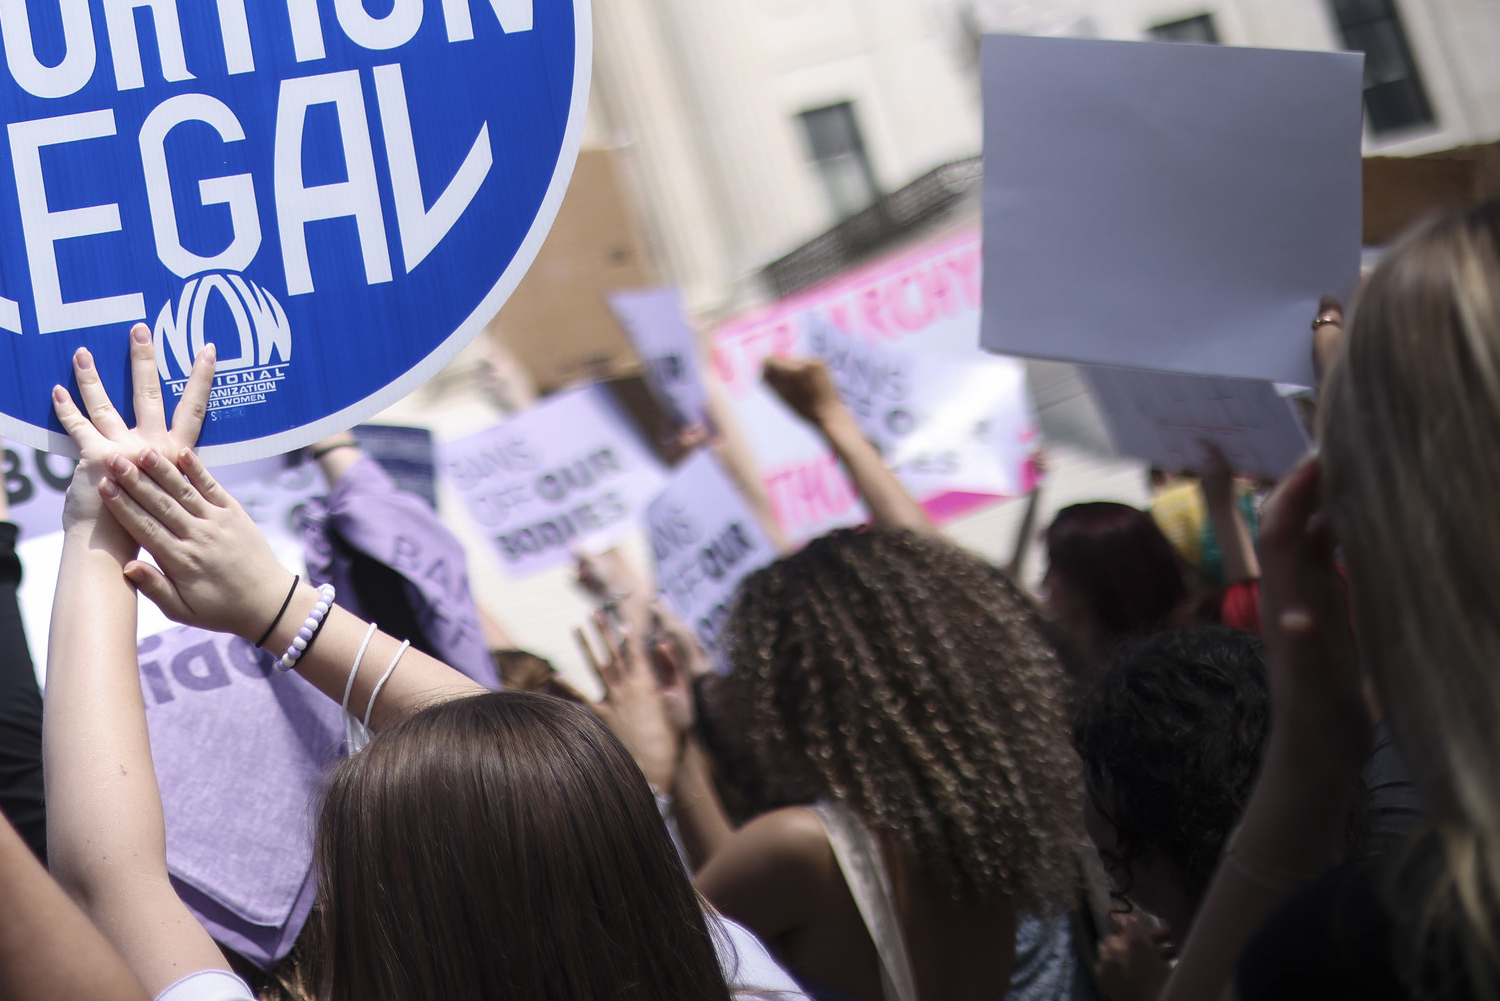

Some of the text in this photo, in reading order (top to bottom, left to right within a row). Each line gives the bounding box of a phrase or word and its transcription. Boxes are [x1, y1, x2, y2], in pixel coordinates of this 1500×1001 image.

[153, 274, 292, 380] NOW
[172, 368, 285, 393] NIONAL
[209, 381, 276, 399] ANIZATION
[206, 394, 266, 409] OR WOMEN
